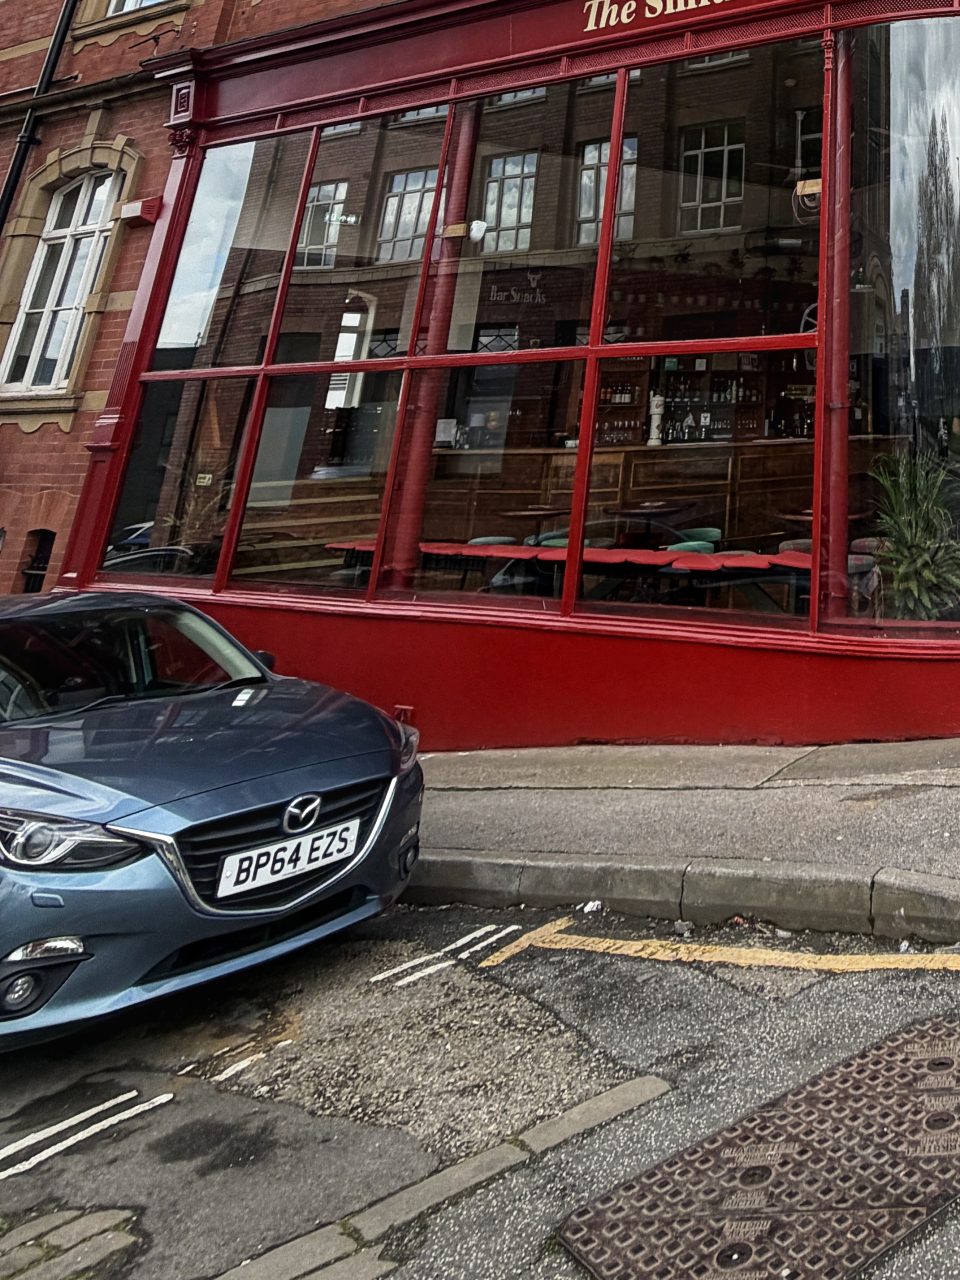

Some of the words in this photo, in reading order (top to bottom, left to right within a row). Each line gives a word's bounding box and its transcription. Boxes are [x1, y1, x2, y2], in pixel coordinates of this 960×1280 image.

[490, 284, 510, 301] Bar
[233, 841, 303, 888] BP64
[306, 826, 350, 865] EZS
